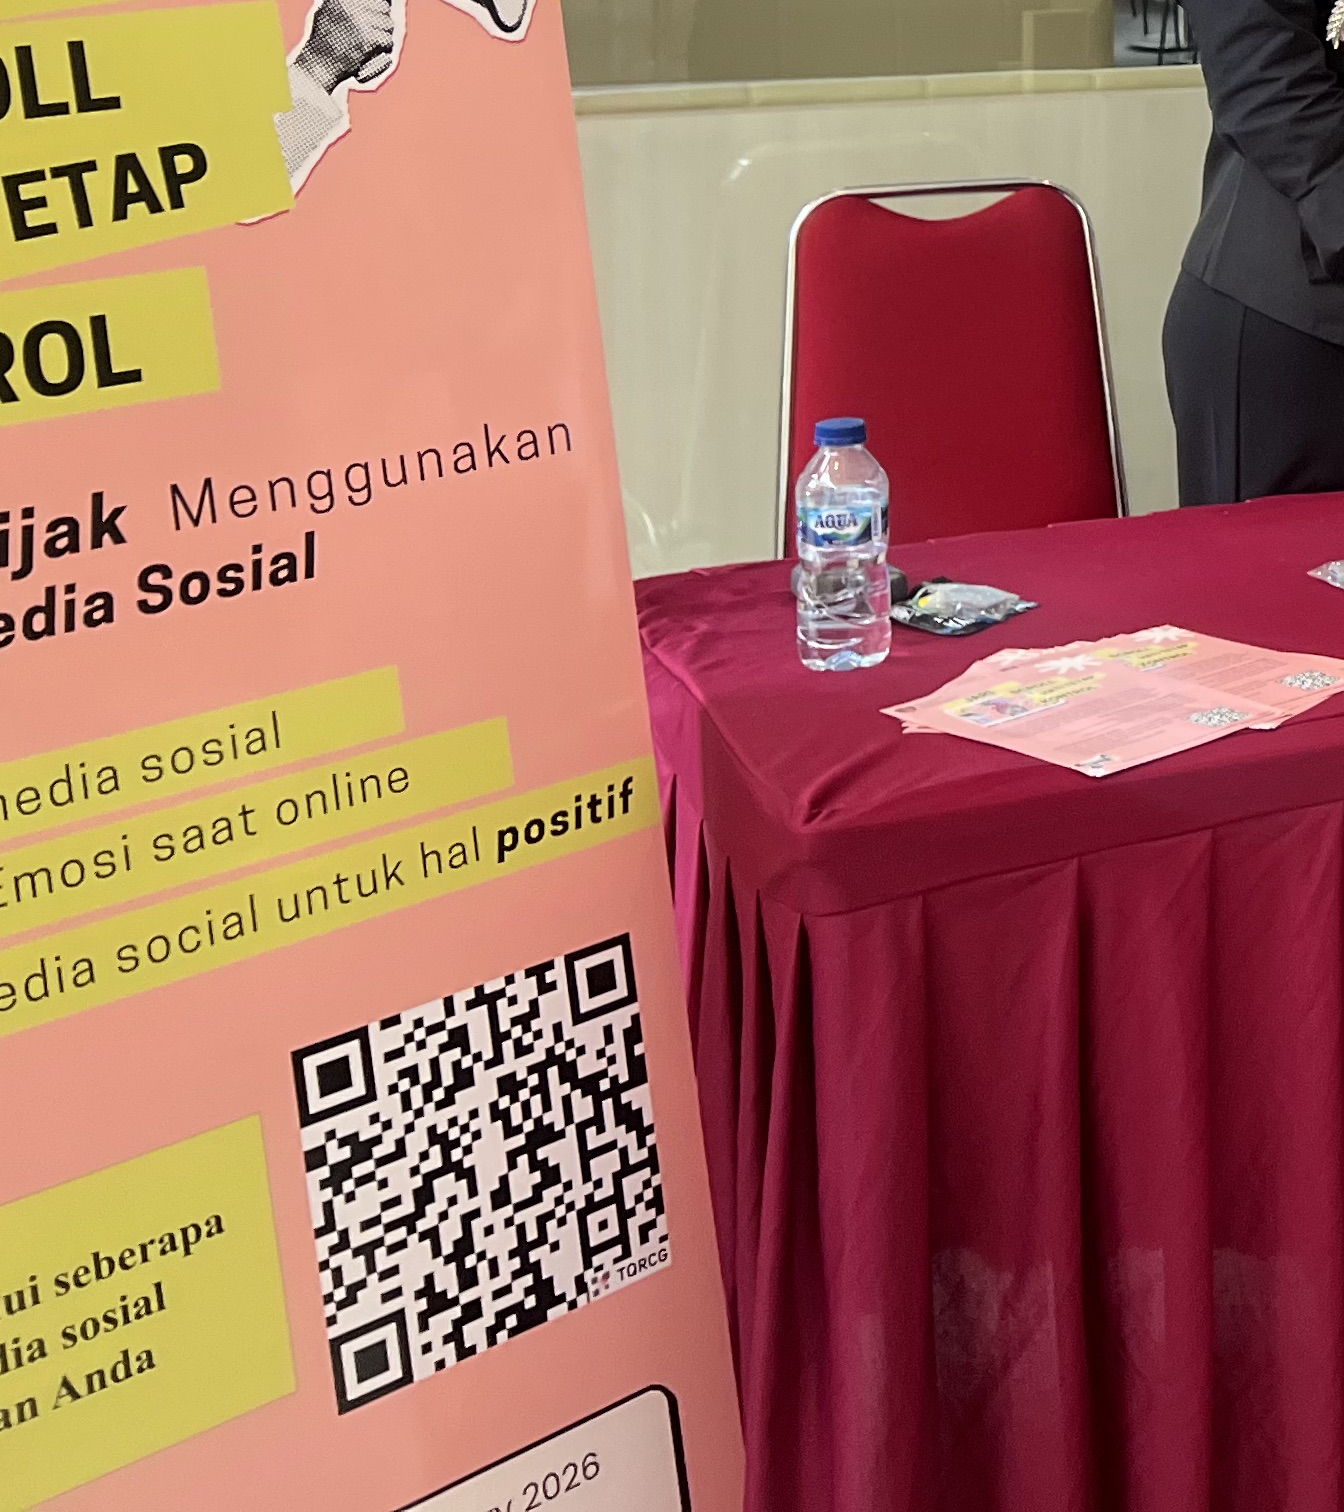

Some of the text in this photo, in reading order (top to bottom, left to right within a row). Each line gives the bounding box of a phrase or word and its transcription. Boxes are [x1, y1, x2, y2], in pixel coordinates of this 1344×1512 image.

[0, 40, 122, 123] LL
[169, 419, 572, 532] Menggunakan
[814, 512, 858, 531] AQUA
[136, 531, 318, 615] Sosial
[140, 710, 282, 785] sosial
[152, 804, 258, 862] saat
[276, 766, 410, 827] online
[116, 893, 259, 975] social
[277, 853, 406, 923] untuk
[420, 826, 481, 879] hal
[496, 776, 635, 863] positif
[0, 1213, 225, 1319] ui seberapa
[61, 1280, 167, 1351] sosial
[51, 1347, 156, 1410] Anda
[521, 1452, 601, 1512] 2026
